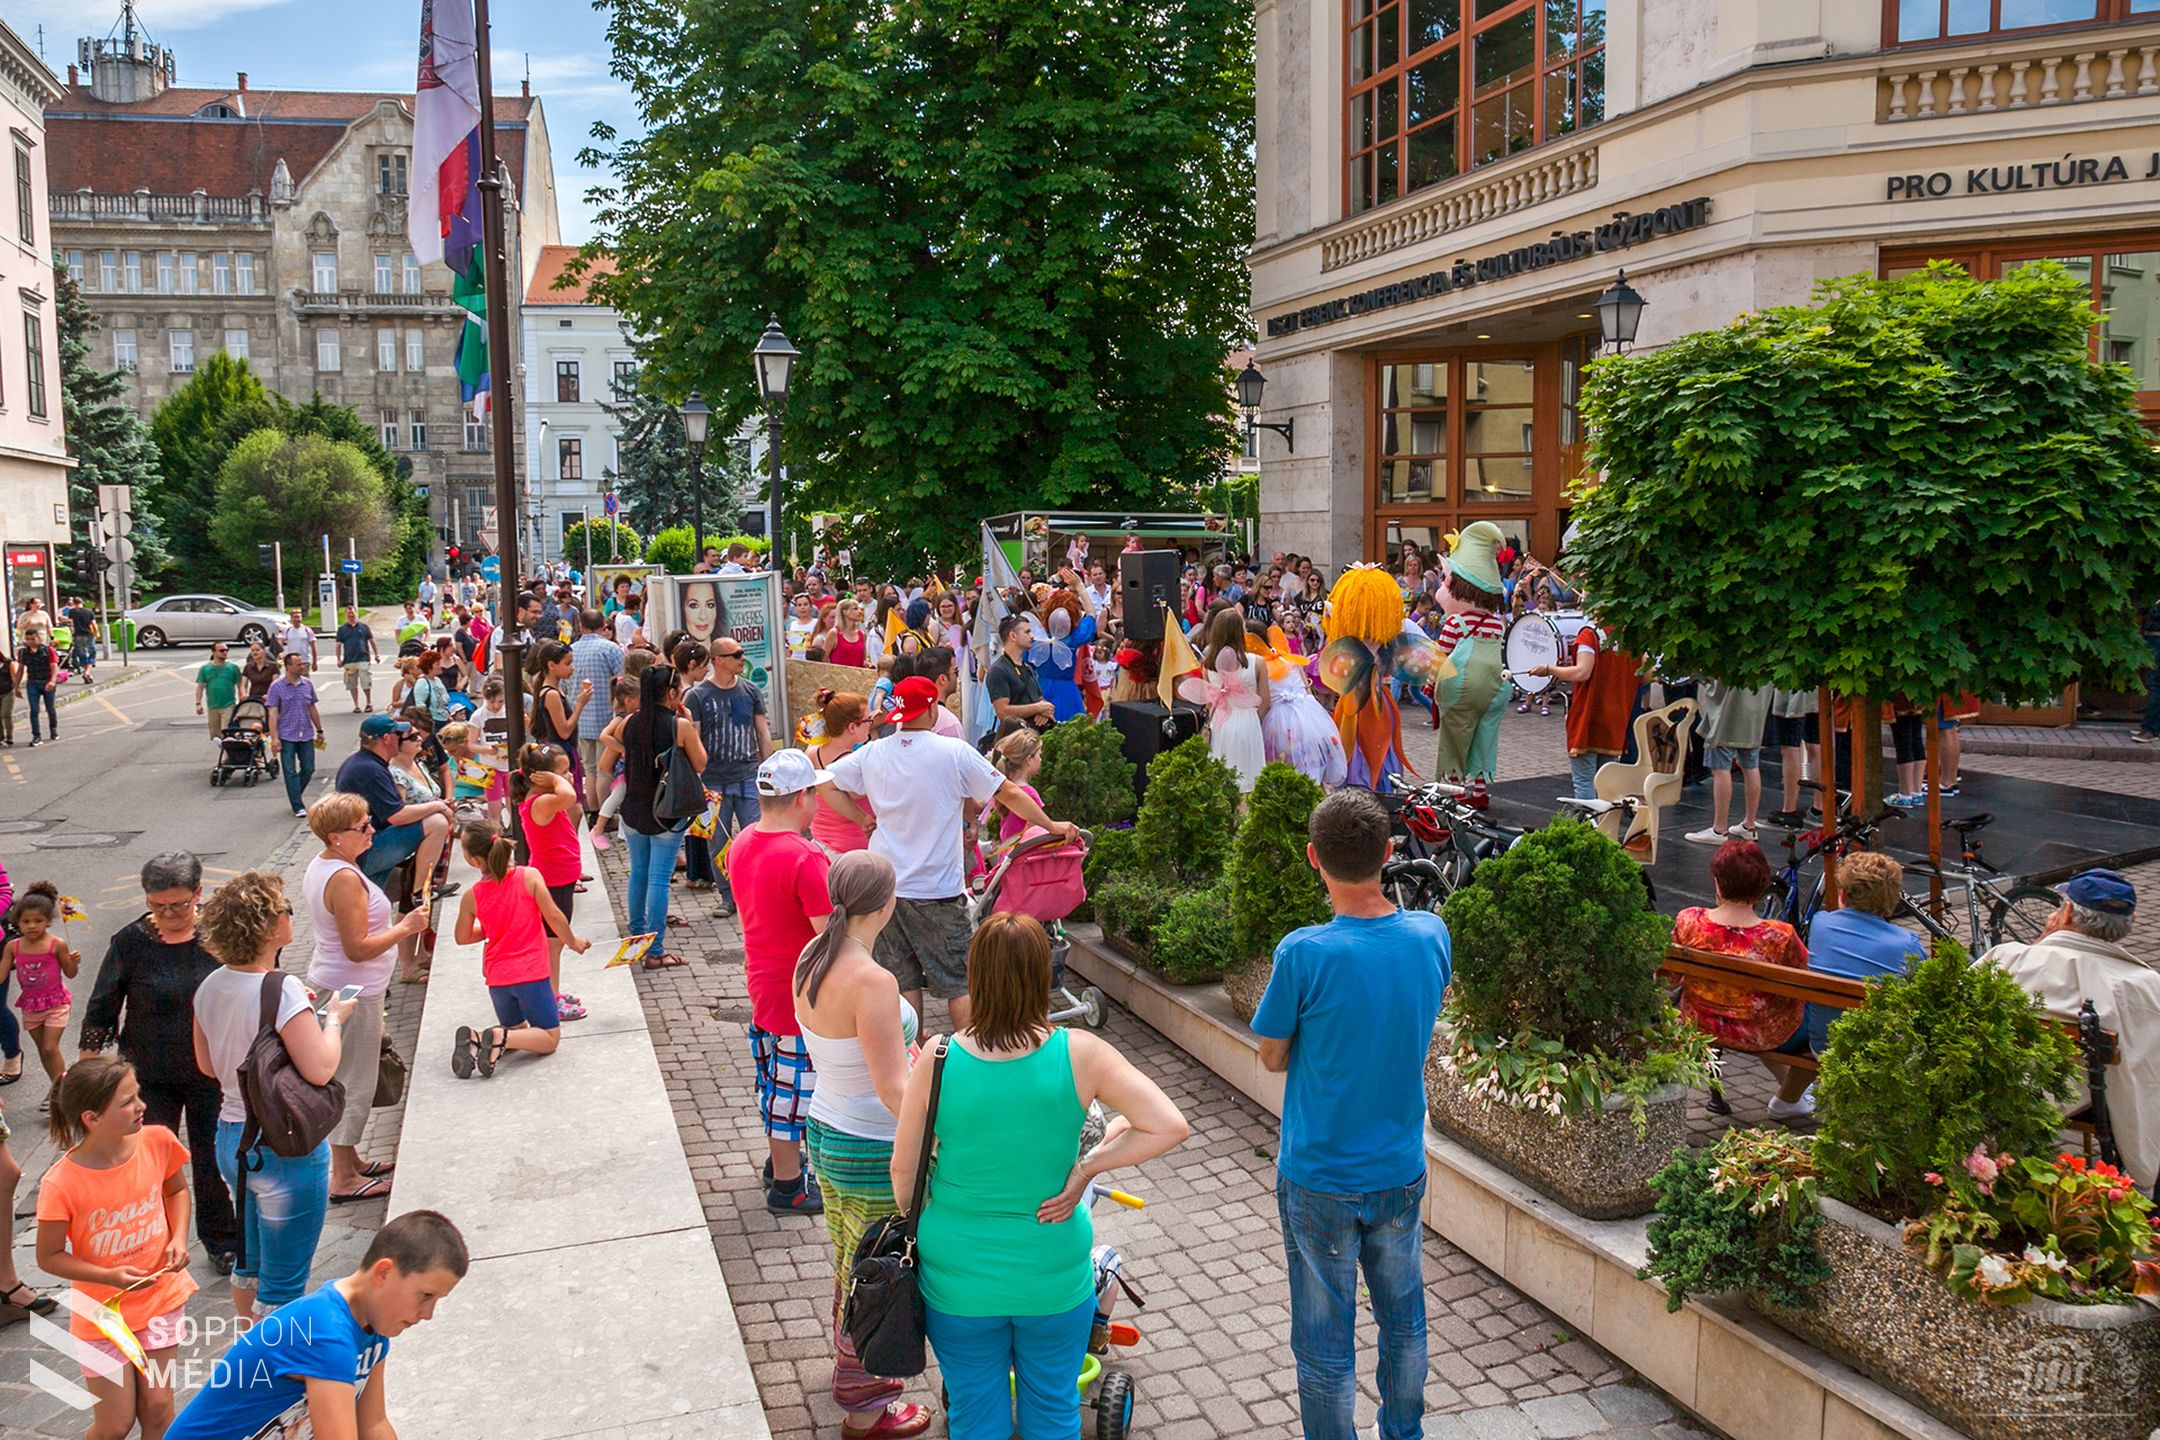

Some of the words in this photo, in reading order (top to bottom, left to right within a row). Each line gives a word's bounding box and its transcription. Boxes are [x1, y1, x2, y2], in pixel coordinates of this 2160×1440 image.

[1887, 172, 1952, 200] PRO
[1967, 153, 2129, 194] KULTÚRA
[1300, 298, 1348, 328] FERENC
[1349, 271, 1450, 315] KONFERENCIA
[1451, 259, 1476, 288] ÉS
[1475, 231, 1592, 283] KULTURÁLIS
[1594, 197, 1710, 251] KÖZPONT
[88, 1184, 159, 1233] Coast
